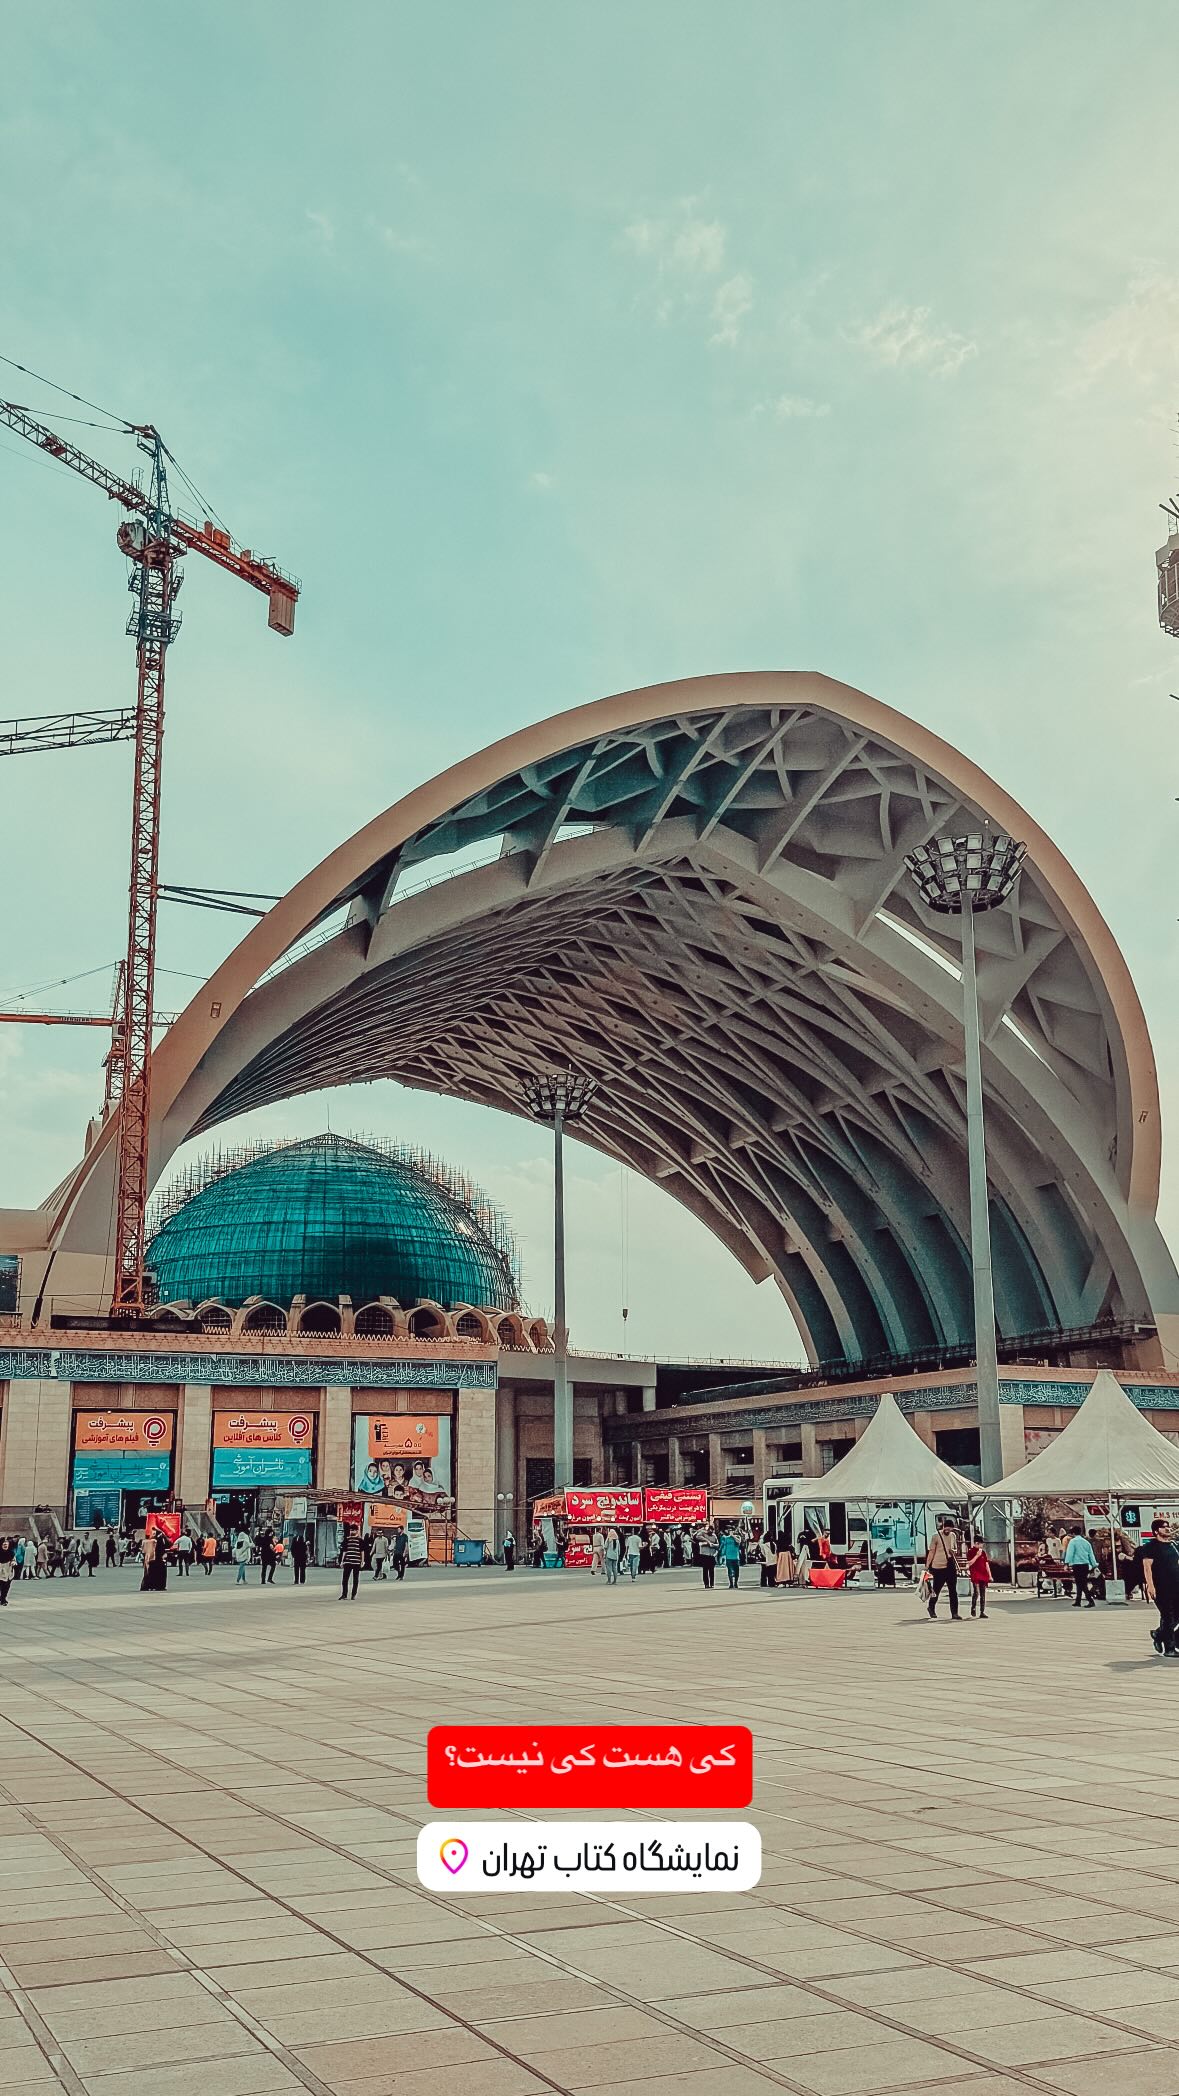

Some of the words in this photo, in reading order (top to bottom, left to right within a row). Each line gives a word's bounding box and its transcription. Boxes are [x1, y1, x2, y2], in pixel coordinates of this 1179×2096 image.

[88, 1416, 134, 1432] پیشرفت
[228, 1414, 277, 1432] پیشرفت
[81, 1432, 109, 1444] آموزشی
[109, 1434, 124, 1444] های
[124, 1432, 139, 1443] فیلم
[223, 1431, 245, 1443] آفلاین
[245, 1433, 261, 1443] های
[262, 1432, 282, 1443] کلاس
[252, 1458, 284, 1474] ناشران
[571, 1495, 594, 1509] سرد
[596, 1492, 639, 1509] ساندویچ
[650, 1490, 673, 1502] قیفی
[673, 1492, 702, 1503] بستنی
